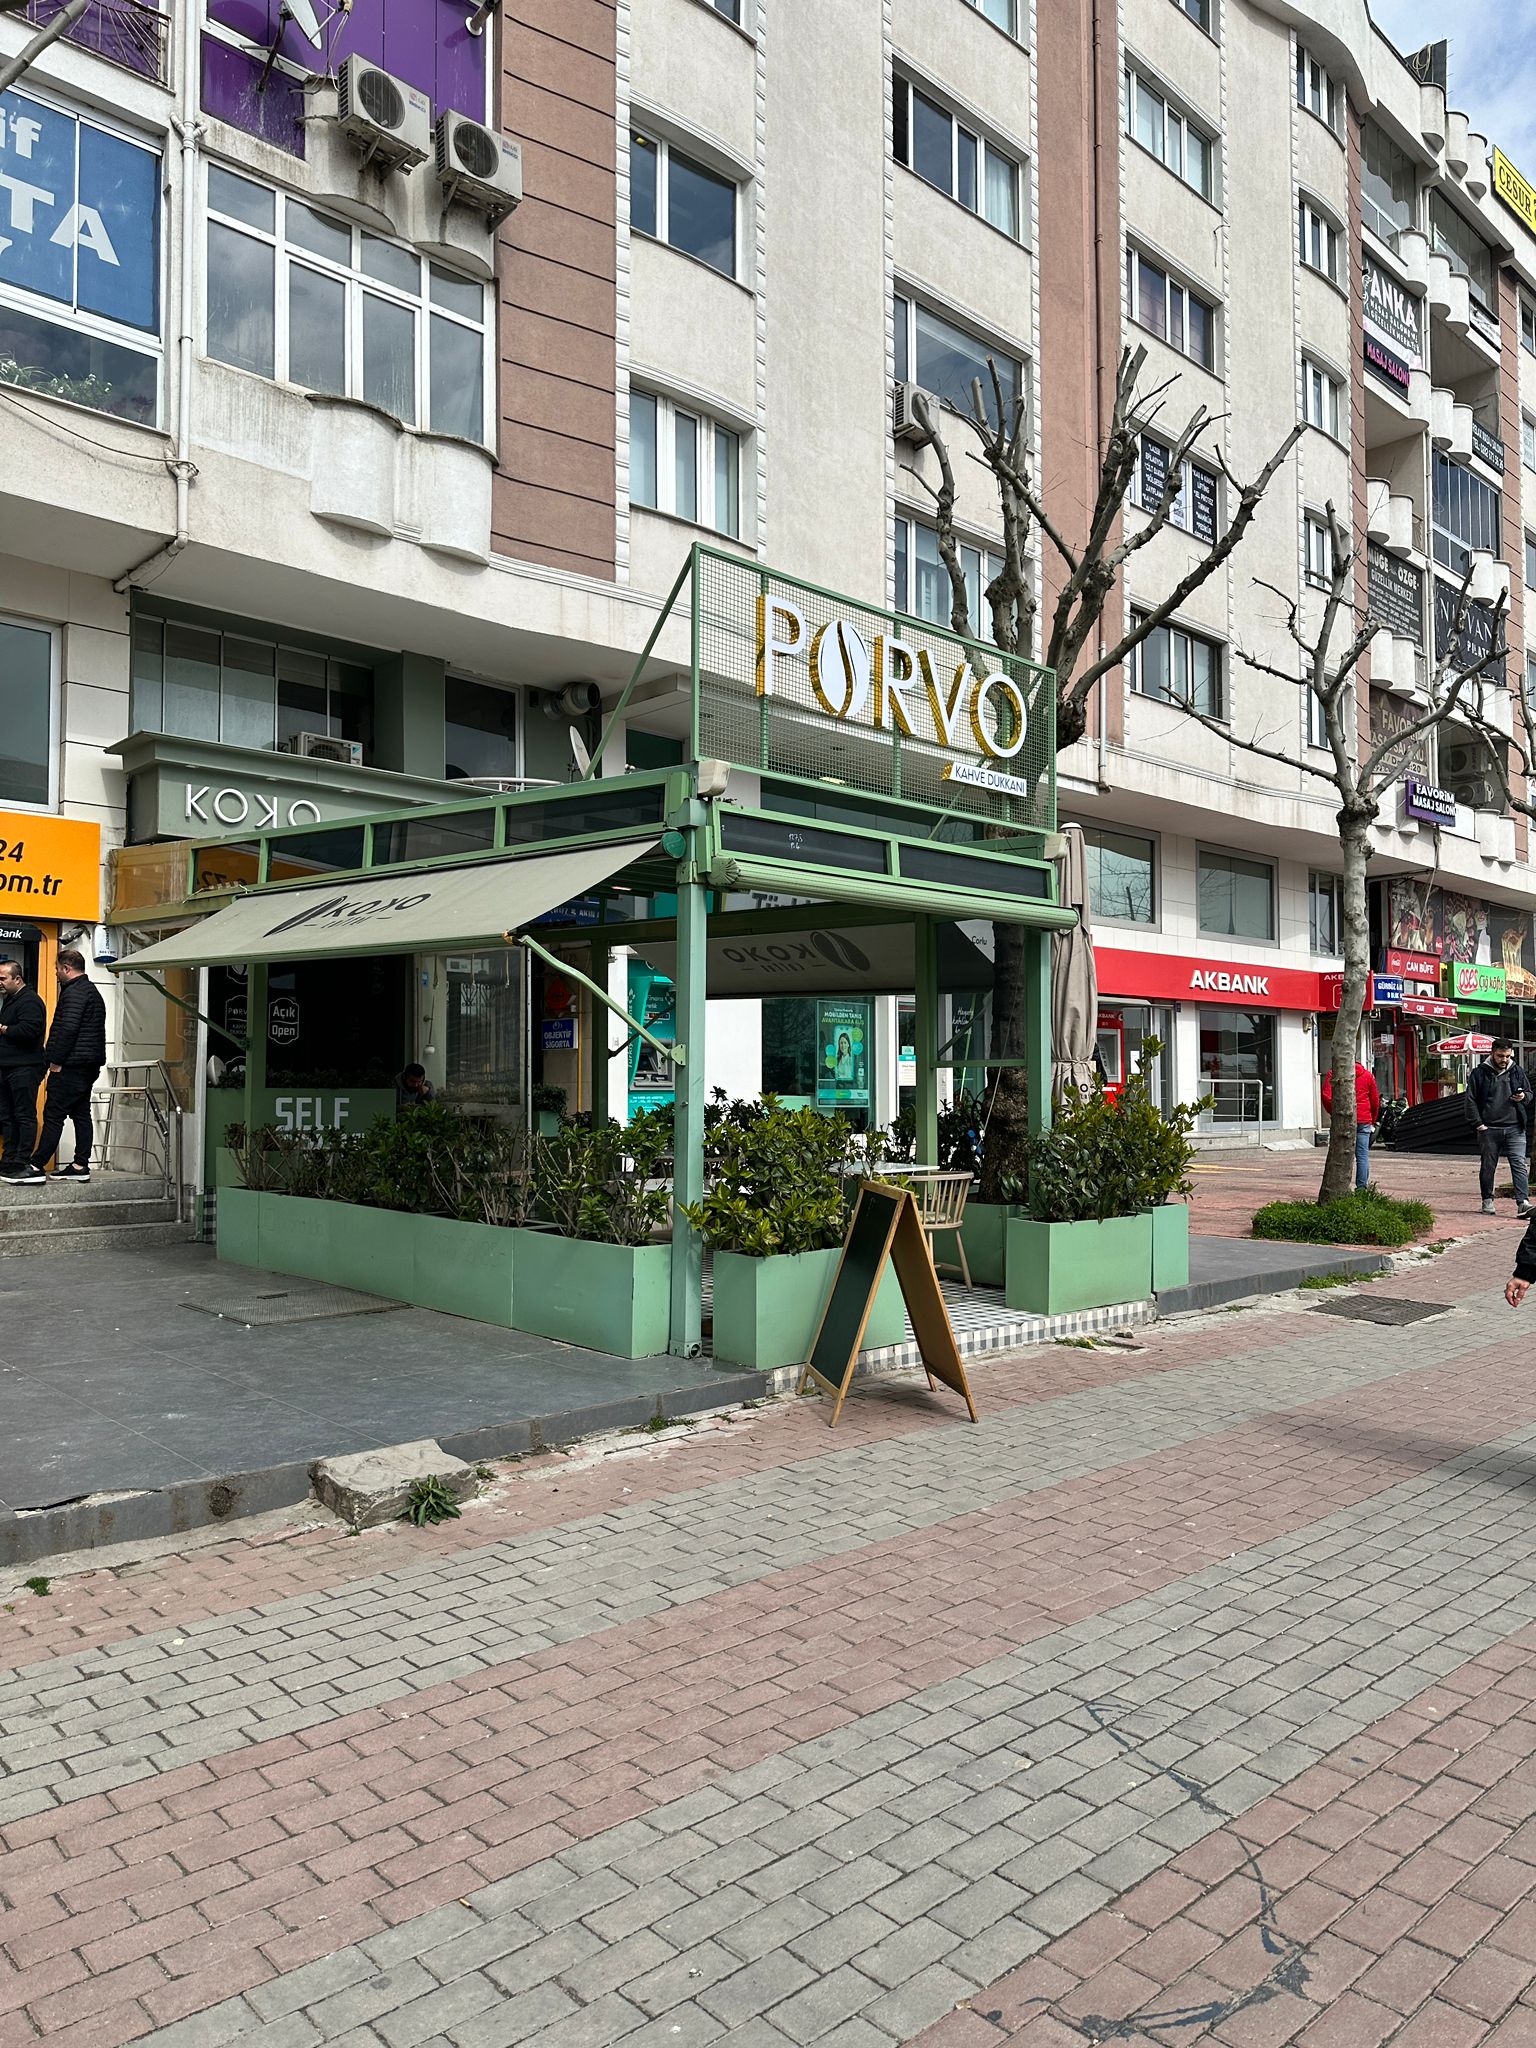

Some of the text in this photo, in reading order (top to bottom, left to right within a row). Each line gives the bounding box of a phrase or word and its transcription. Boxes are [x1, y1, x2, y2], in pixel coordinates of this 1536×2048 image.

[1499, 165, 1532, 217] CESUR
[1370, 269, 1418, 333] ANKA
[1368, 546, 1389, 573] MÜGE
[1398, 562, 1418, 590] ÖZGE
[757, 594, 1027, 758] PORVO
[955, 764, 986, 785] KAHVE
[1412, 795, 1435, 811] MASAJ
[1416, 784, 1455, 804] FAVORİM
[1406, 961, 1418, 972] CAN
[1419, 961, 1435, 975] BÜFE
[1190, 968, 1270, 996] AKBANK
[1324, 974, 1345, 982] AKB
[273, 1005, 296, 1020] Açık
[271, 1024, 296, 1038] Open
[543, 1028, 572, 1040] OBJEKTİF
[545, 1040, 570, 1049] SİGORTA
